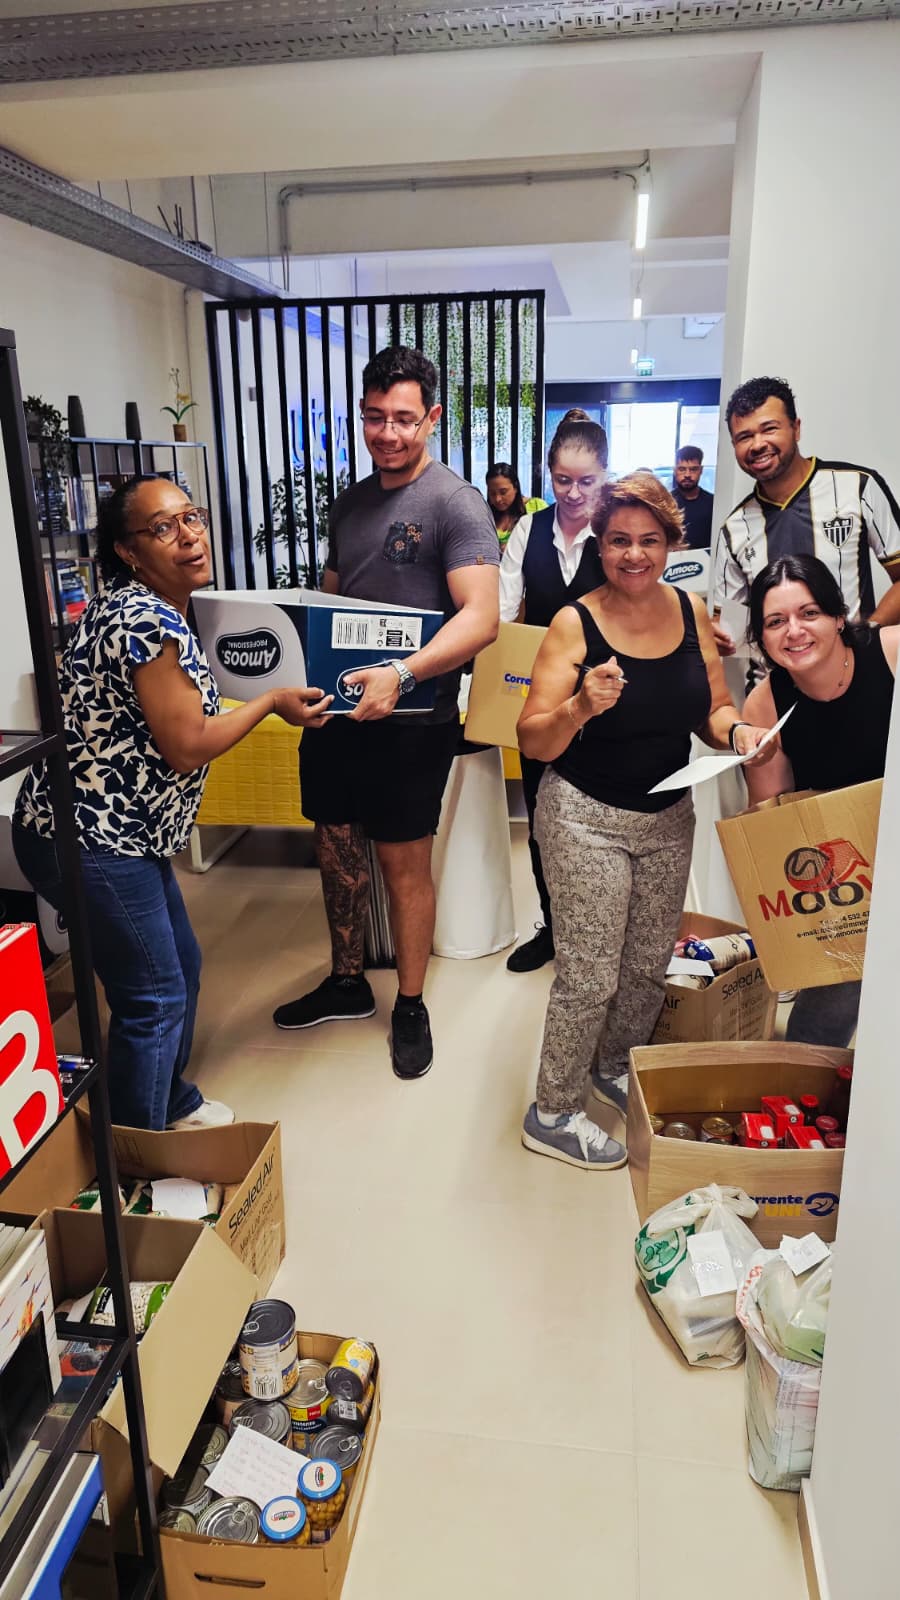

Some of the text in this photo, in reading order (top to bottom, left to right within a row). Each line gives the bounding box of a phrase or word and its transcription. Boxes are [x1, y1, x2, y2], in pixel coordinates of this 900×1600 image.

[664, 563, 700, 579] Amoos
[223, 646, 277, 669] Amoos
[504, 673, 533, 686] Corre
[228, 1153, 275, 1240] Sealed Air
[765, 1205, 802, 1217] UNI
